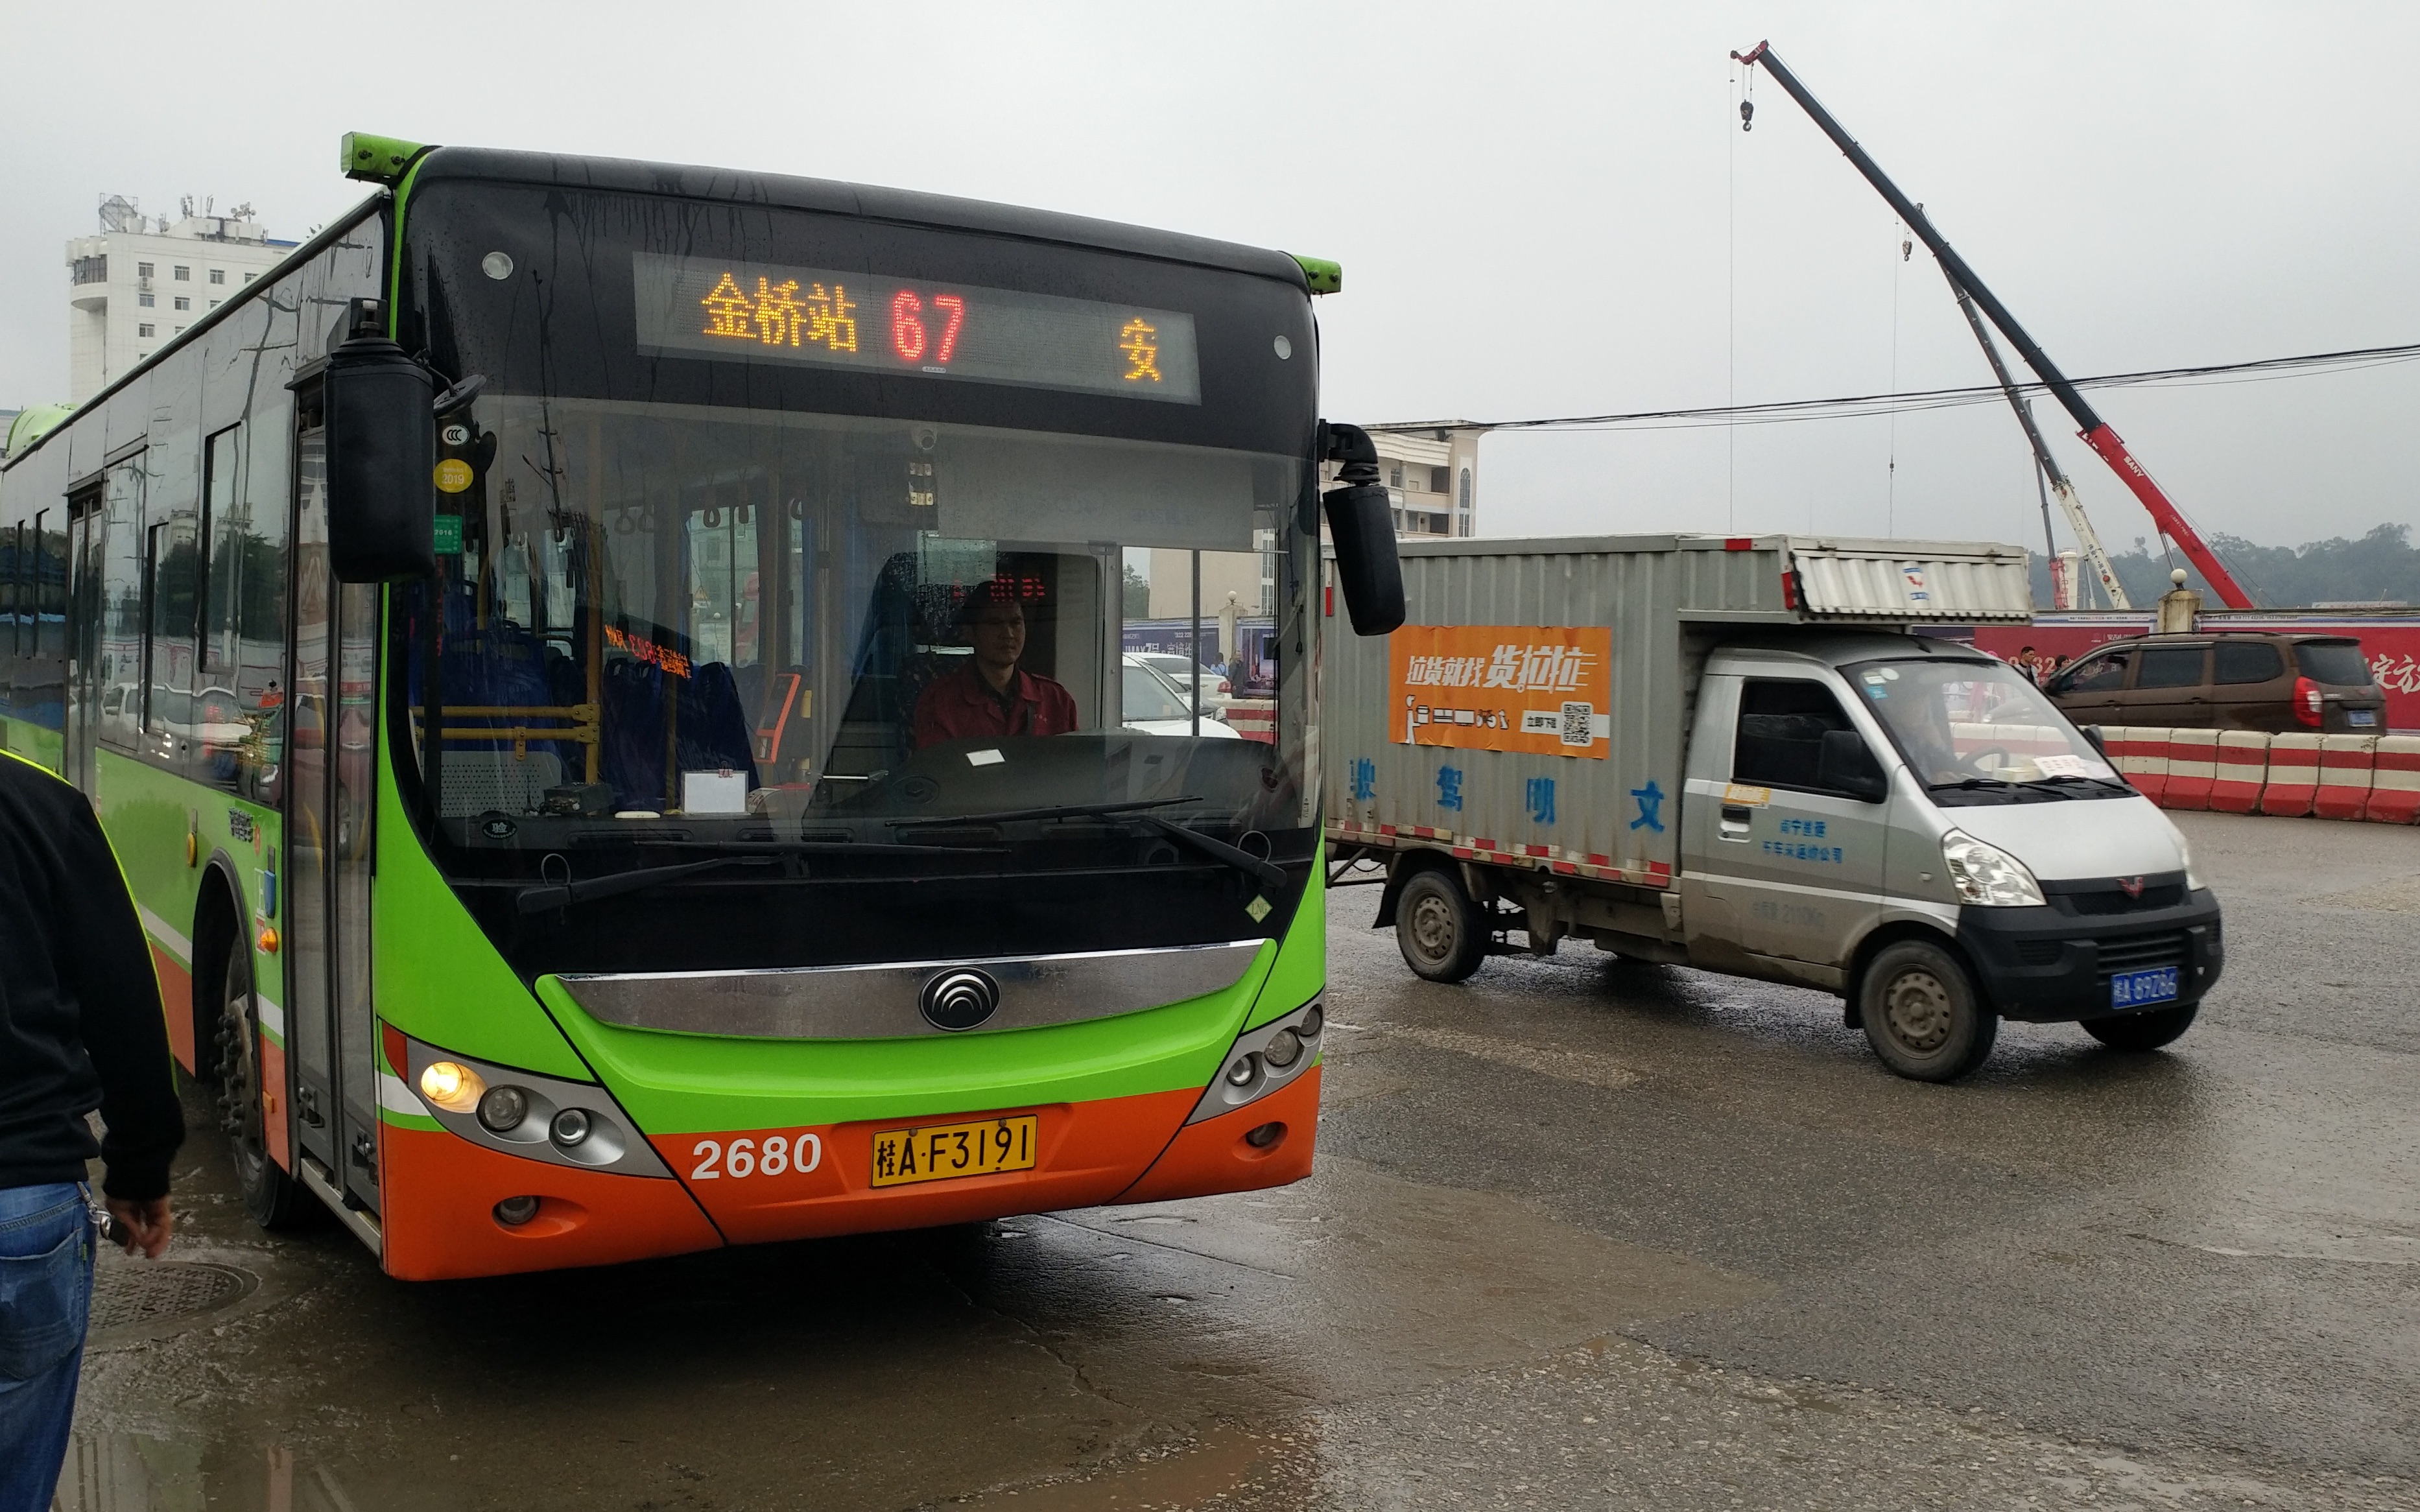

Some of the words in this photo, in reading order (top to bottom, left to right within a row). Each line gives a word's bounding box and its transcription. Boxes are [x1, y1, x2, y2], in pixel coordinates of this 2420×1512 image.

[702, 272, 857, 353] 金桥站
[894, 290, 964, 362] 67
[1120, 318, 1162, 382] 安
[2122, 456, 2144, 478] SANY
[1252, 903, 1269, 915] LNG
[691, 1133, 822, 1180] 2680
